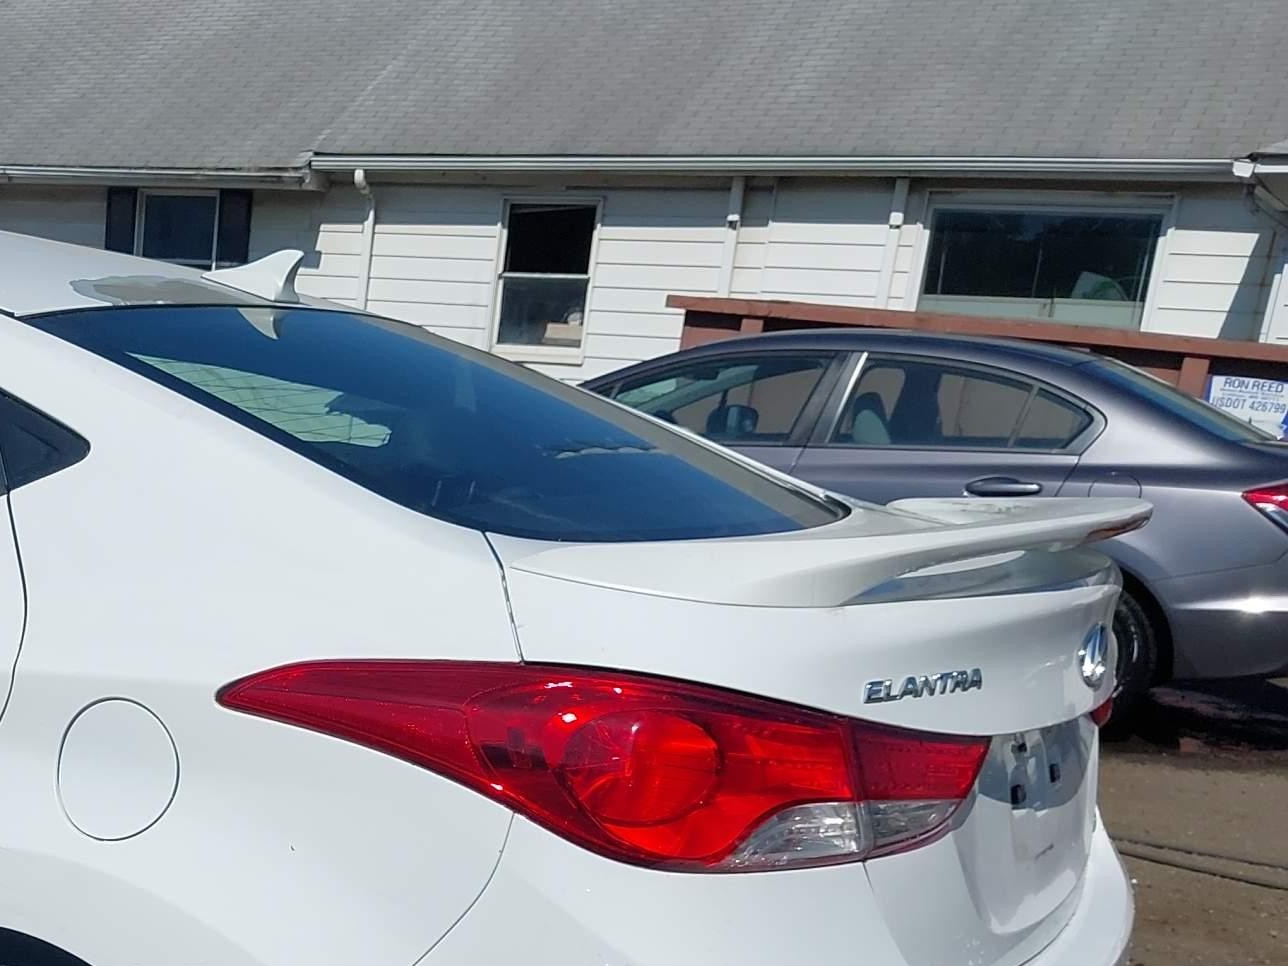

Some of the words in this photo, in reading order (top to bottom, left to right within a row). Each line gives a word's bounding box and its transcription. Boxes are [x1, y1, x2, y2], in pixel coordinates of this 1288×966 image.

[1223, 377, 1249, 390] RON
[1251, 380, 1284, 393] REED
[863, 668, 983, 704] ELANTRA
